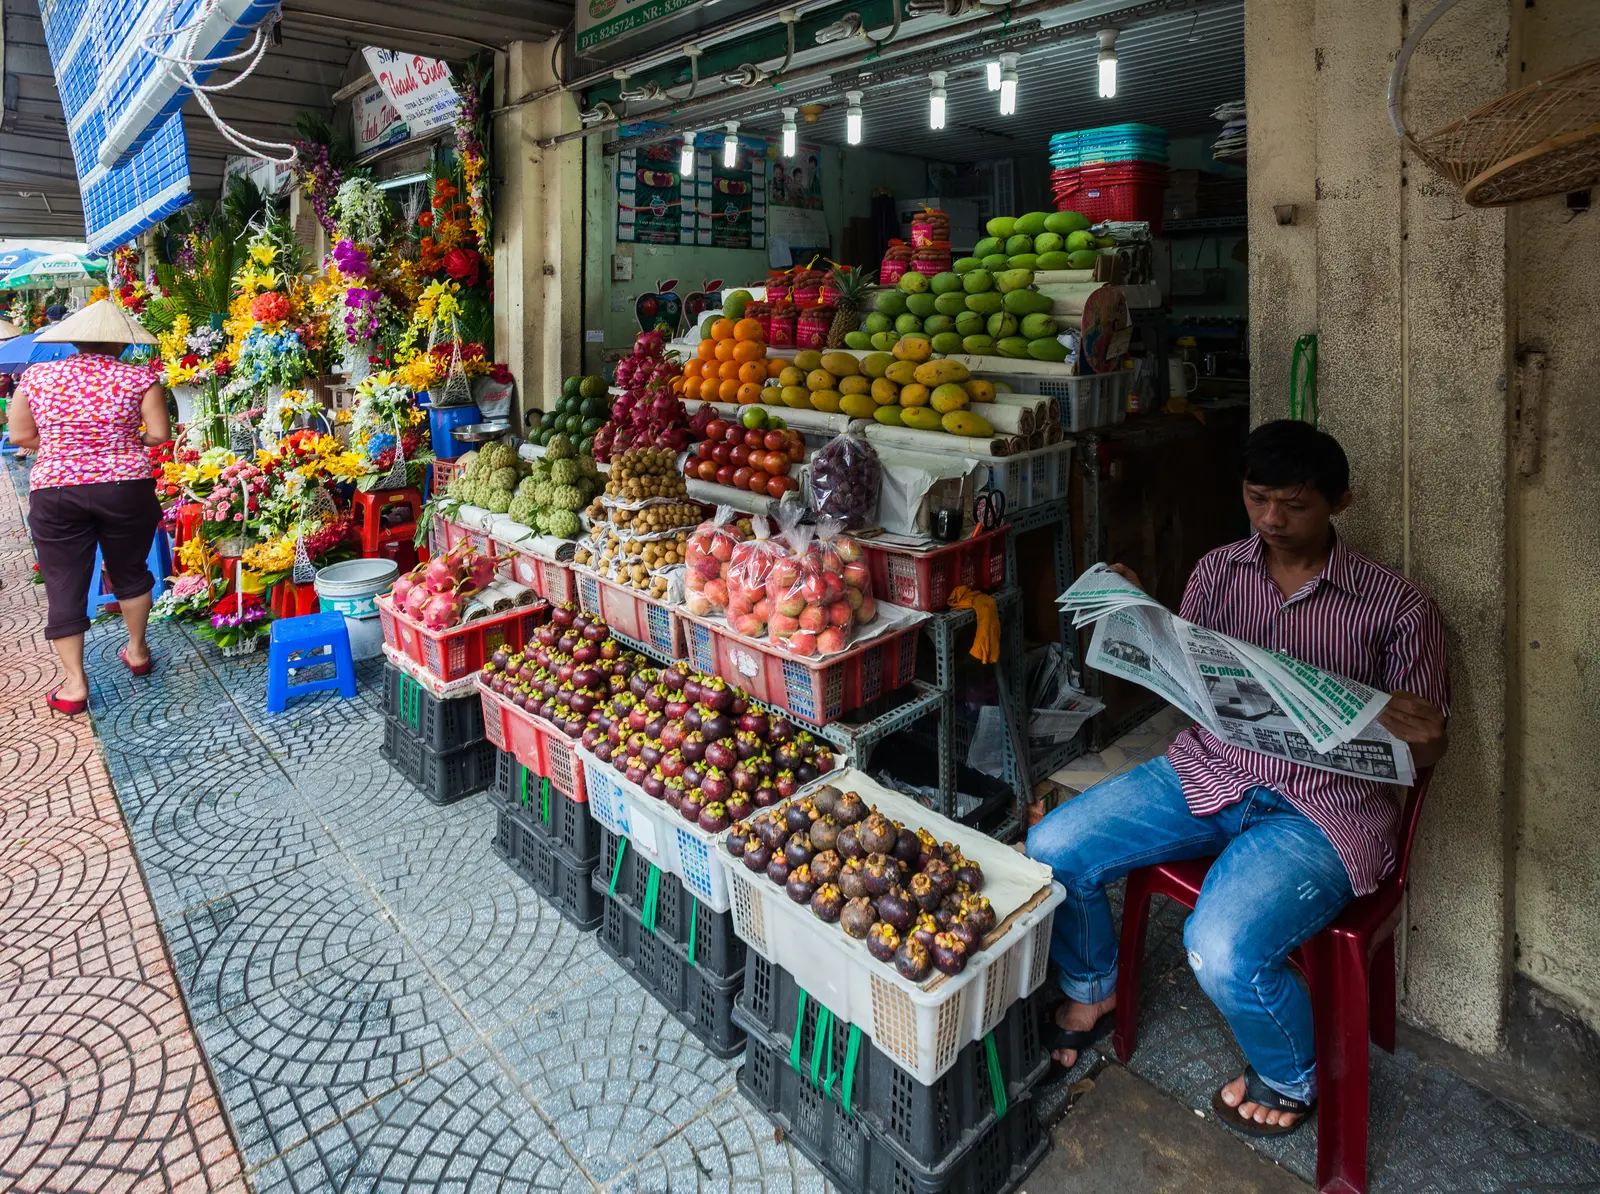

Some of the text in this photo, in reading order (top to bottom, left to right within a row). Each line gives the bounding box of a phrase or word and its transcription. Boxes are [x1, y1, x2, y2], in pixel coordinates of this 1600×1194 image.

[581, 31, 598, 48] ĐT:
[599, 15, 635, 40] 8245724
[642, 5, 662, 22] NR:
[379, 54, 447, 100] Thanh Bình
[1189, 646, 1208, 655] GIA
